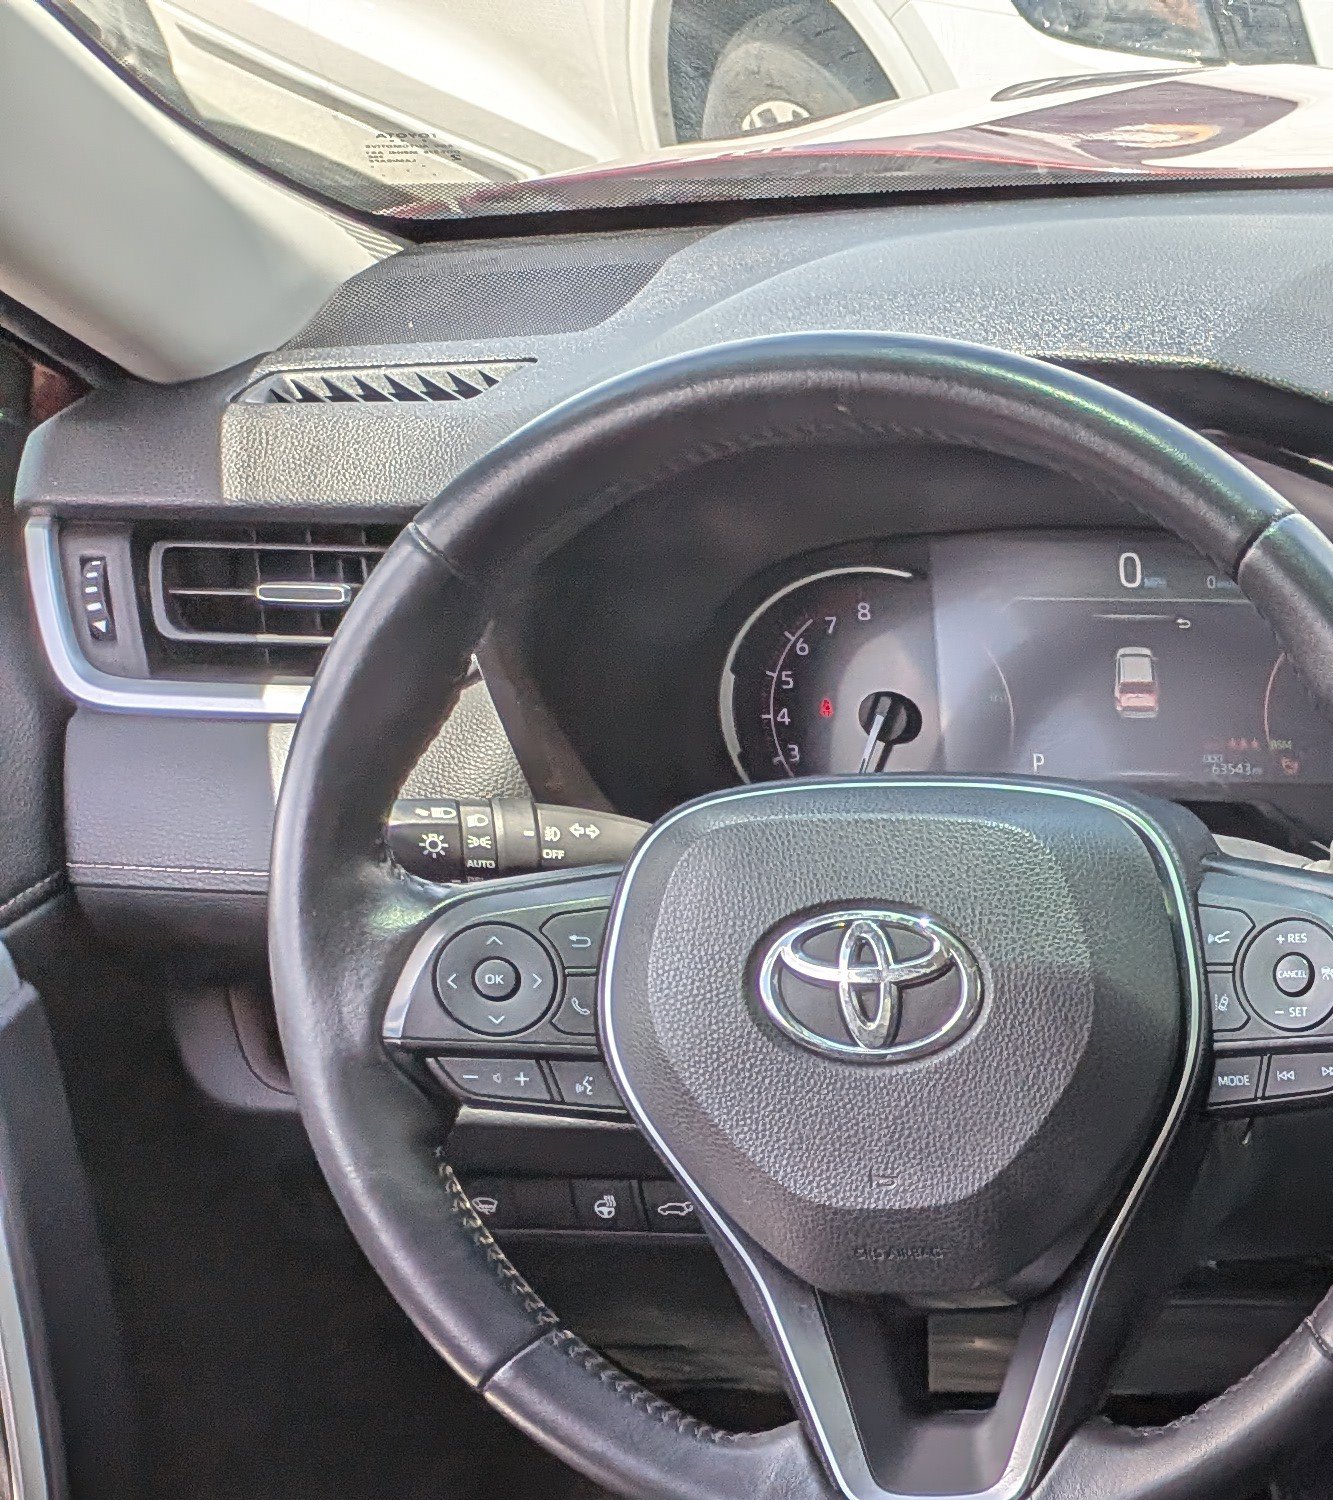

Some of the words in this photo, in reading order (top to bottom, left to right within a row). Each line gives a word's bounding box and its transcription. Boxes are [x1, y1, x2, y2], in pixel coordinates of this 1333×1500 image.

[1119, 552, 1142, 588] 0
[857, 602, 871, 620] 8
[824, 616, 837, 634] 7
[795, 637, 810, 656] 6
[781, 670, 794, 689] 5
[776, 707, 791, 726] 4
[787, 744, 800, 762] 3
[1033, 752, 1045, 772] P
[542, 848, 566, 860] OFF
[466, 858, 496, 869] AUTO
[1287, 932, 1308, 944] RES
[485, 973, 505, 985] OK
[1277, 969, 1308, 979] CANCEL
[1289, 1006, 1308, 1017] SET
[1217, 1075, 1251, 1087] MODE
